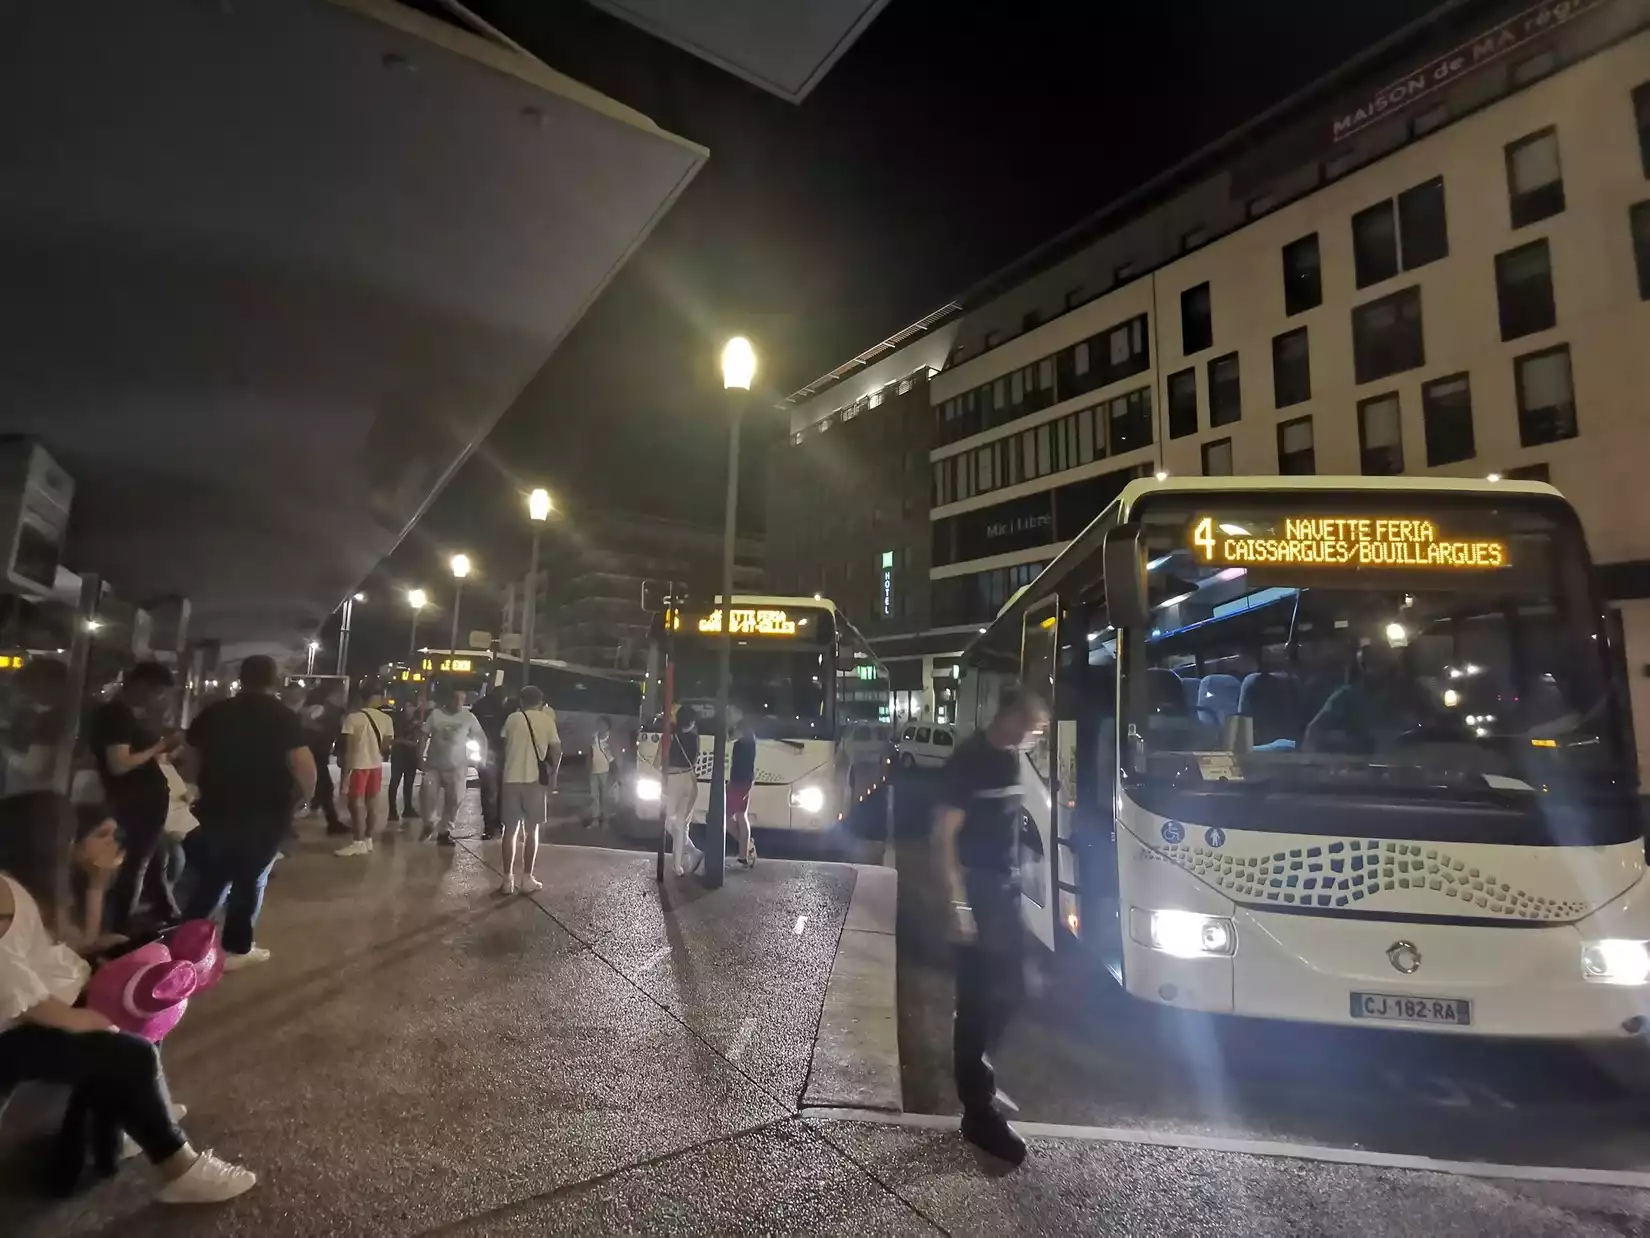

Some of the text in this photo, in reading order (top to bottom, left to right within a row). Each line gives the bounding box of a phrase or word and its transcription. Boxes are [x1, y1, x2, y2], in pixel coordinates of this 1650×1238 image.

[1332, 76, 1425, 136] MAISON
[1434, 55, 1465, 81] de
[1472, 29, 1516, 60] MA
[1194, 517, 1216, 560] 4
[1286, 518, 1434, 542] NAVETTE FERIA
[1224, 539, 1502, 565] CAISSARGUES/BOUILLARGUES
